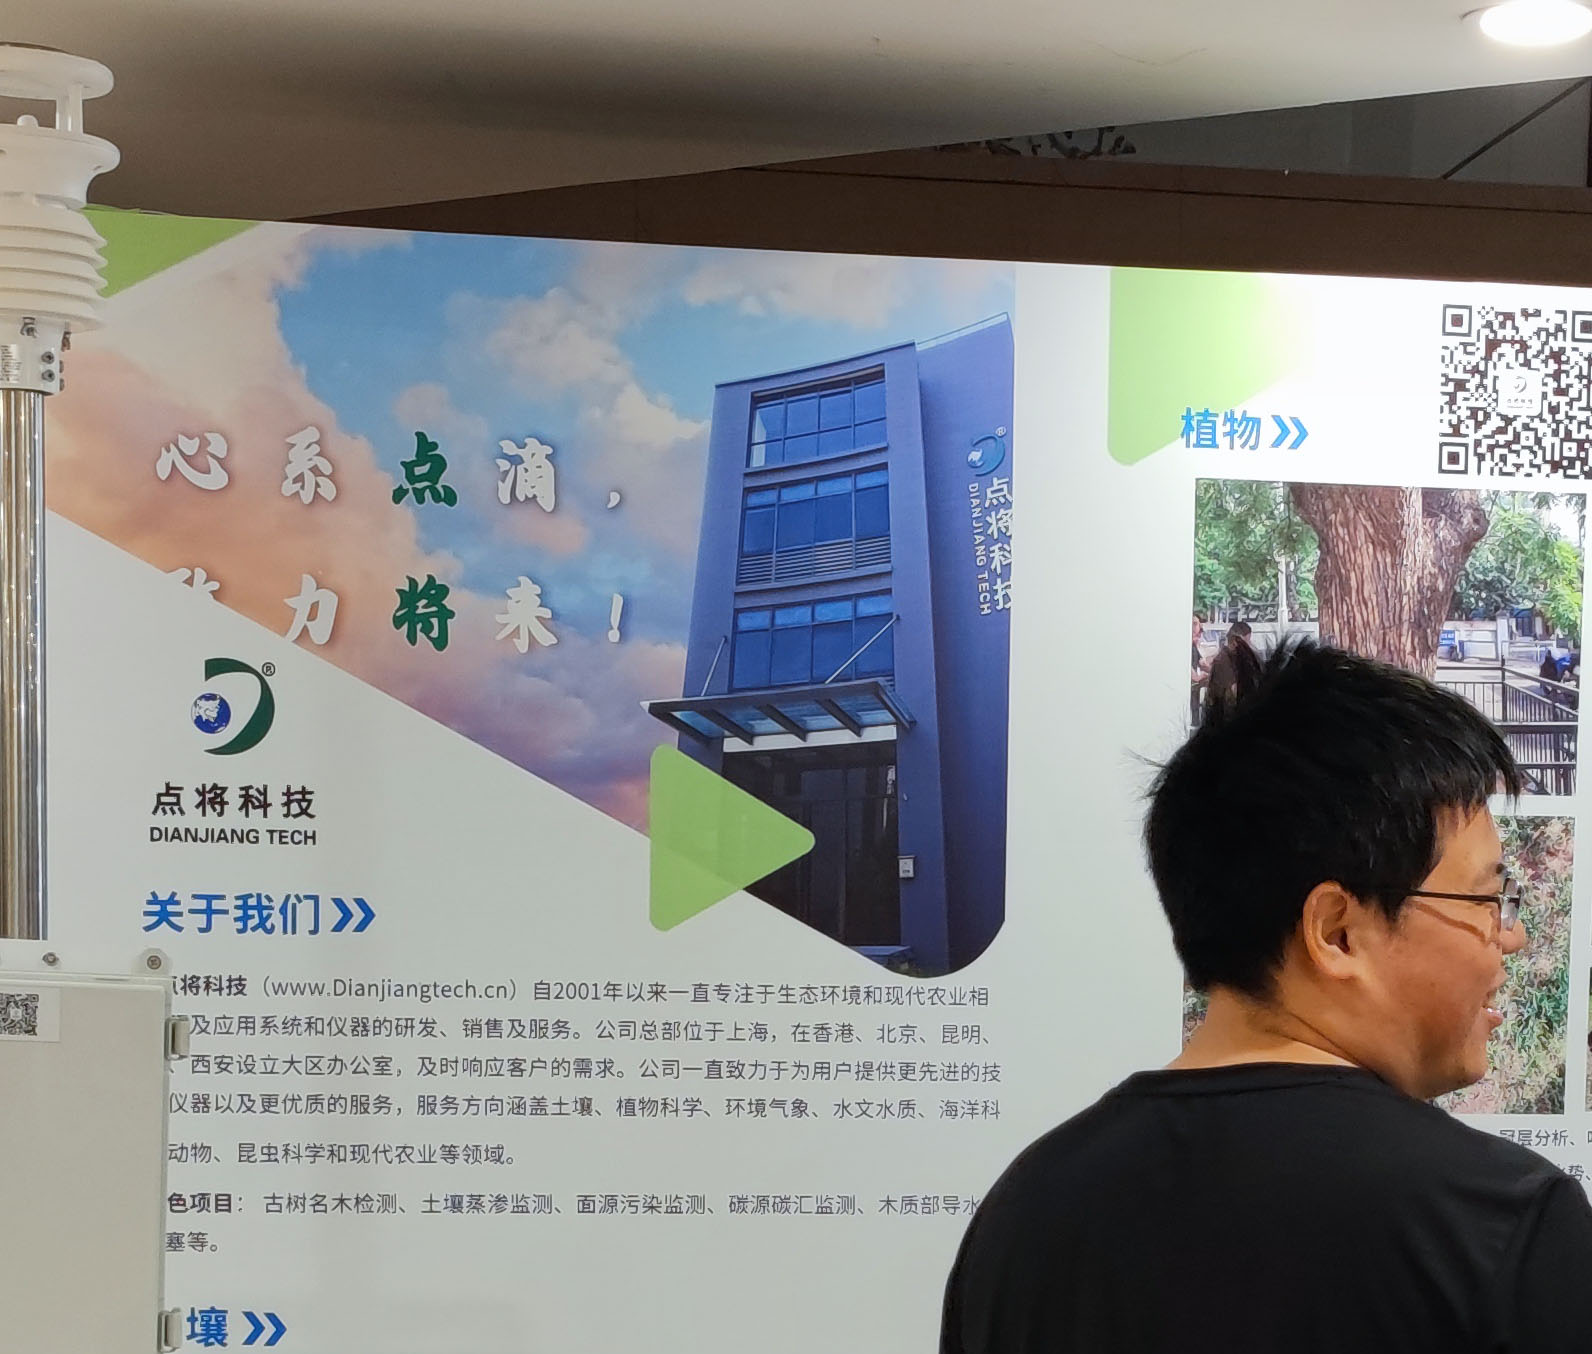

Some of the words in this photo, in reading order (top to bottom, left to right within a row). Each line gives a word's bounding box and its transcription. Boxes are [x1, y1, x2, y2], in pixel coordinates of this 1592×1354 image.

[1180, 406, 1262, 451] 植物
[968, 482, 986, 567] DIANJIANG
[977, 570, 991, 616] TECH
[152, 782, 316, 819] 点将科技
[149, 826, 259, 845] DIANJIANG
[266, 829, 317, 846] TECH
[142, 891, 321, 935] 关于我们
[171, 1014, 995, 1046] 及应用系统和仪器的研发、销售及服务。公司总部位于上海，在香港、北京、昆明、
[186, 1306, 229, 1348] 壤
